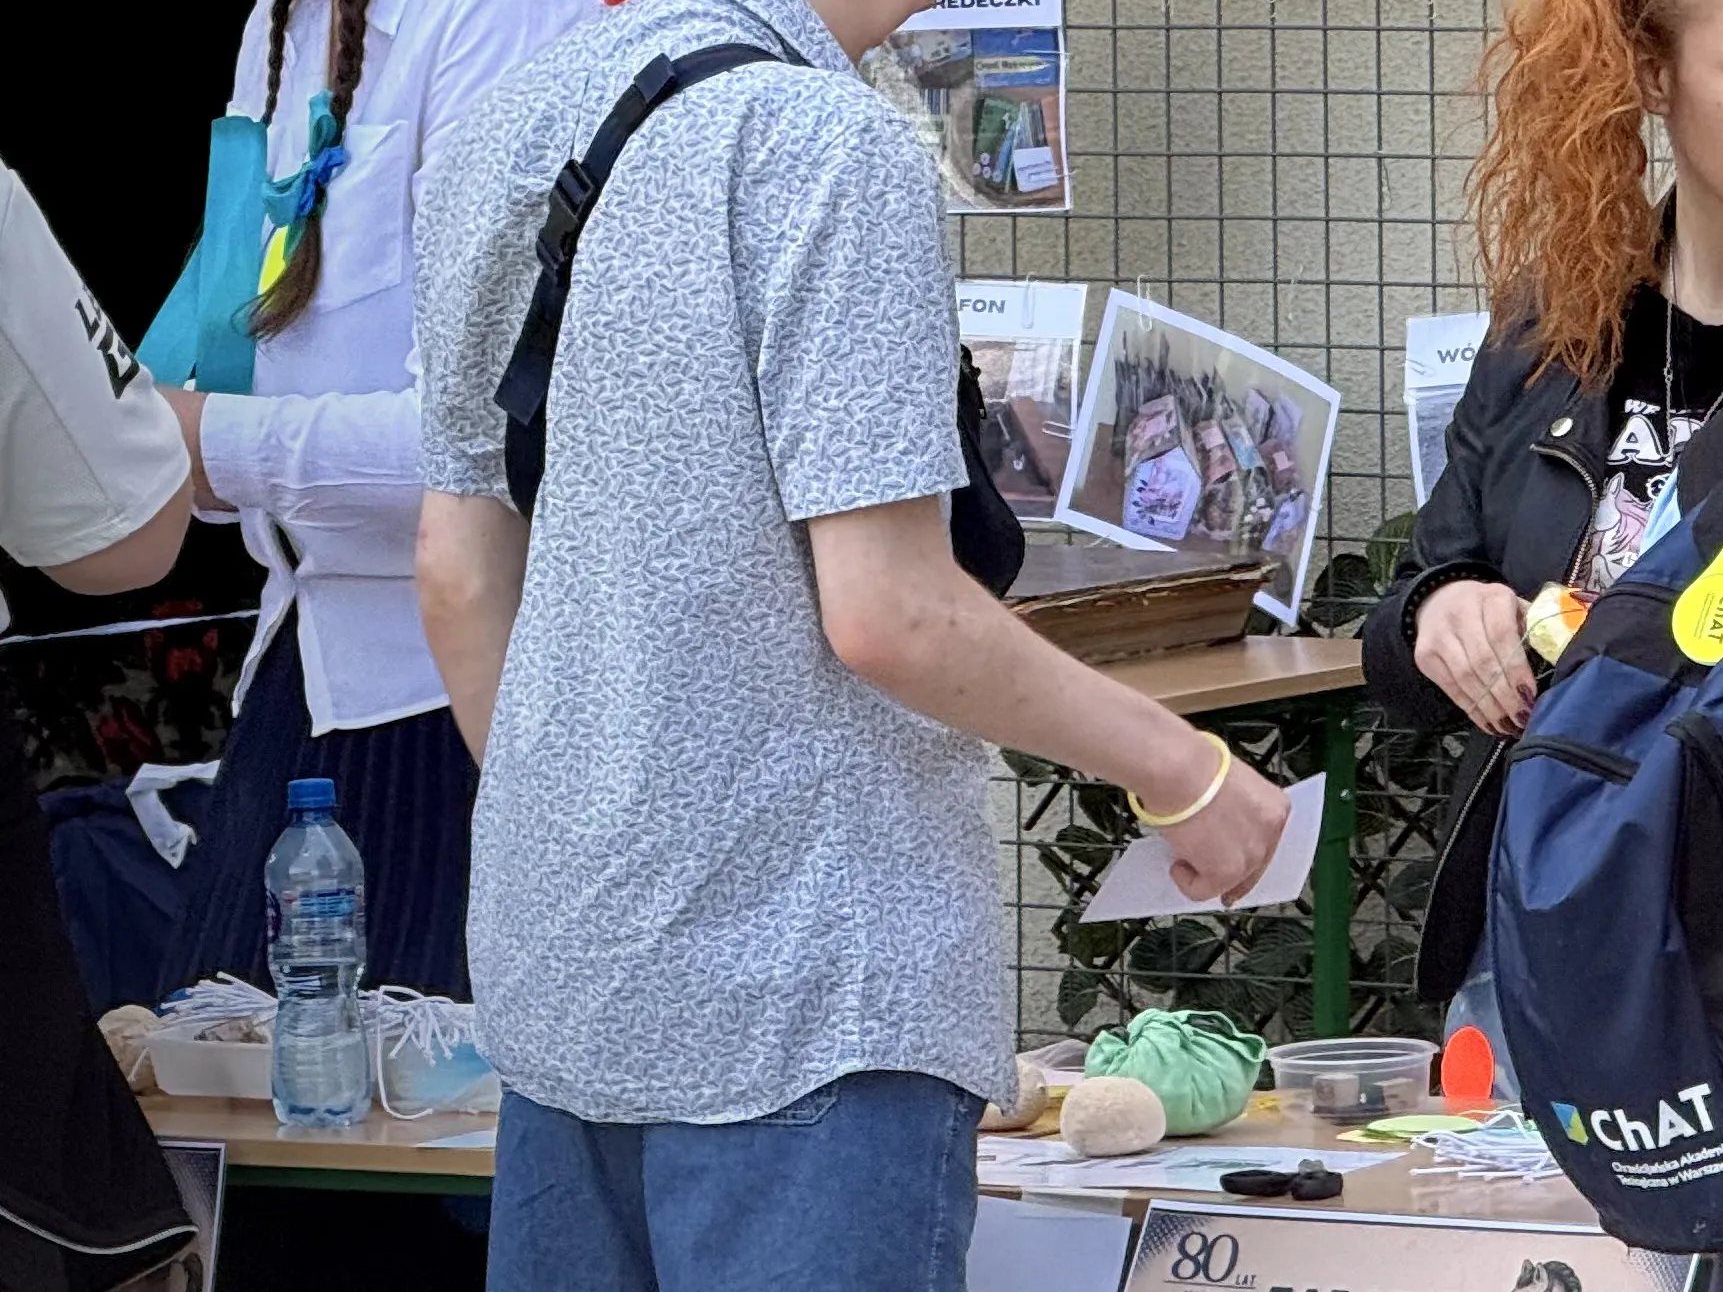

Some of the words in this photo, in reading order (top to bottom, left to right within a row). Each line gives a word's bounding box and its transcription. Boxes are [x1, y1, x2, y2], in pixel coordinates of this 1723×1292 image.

[957, 298, 1006, 314] FON
[1436, 342, 1477, 364] WÓ
[1590, 1083, 1714, 1152] ChAT
[1170, 1230, 1240, 1283] 80
[1234, 1273, 1257, 1286] LAT
